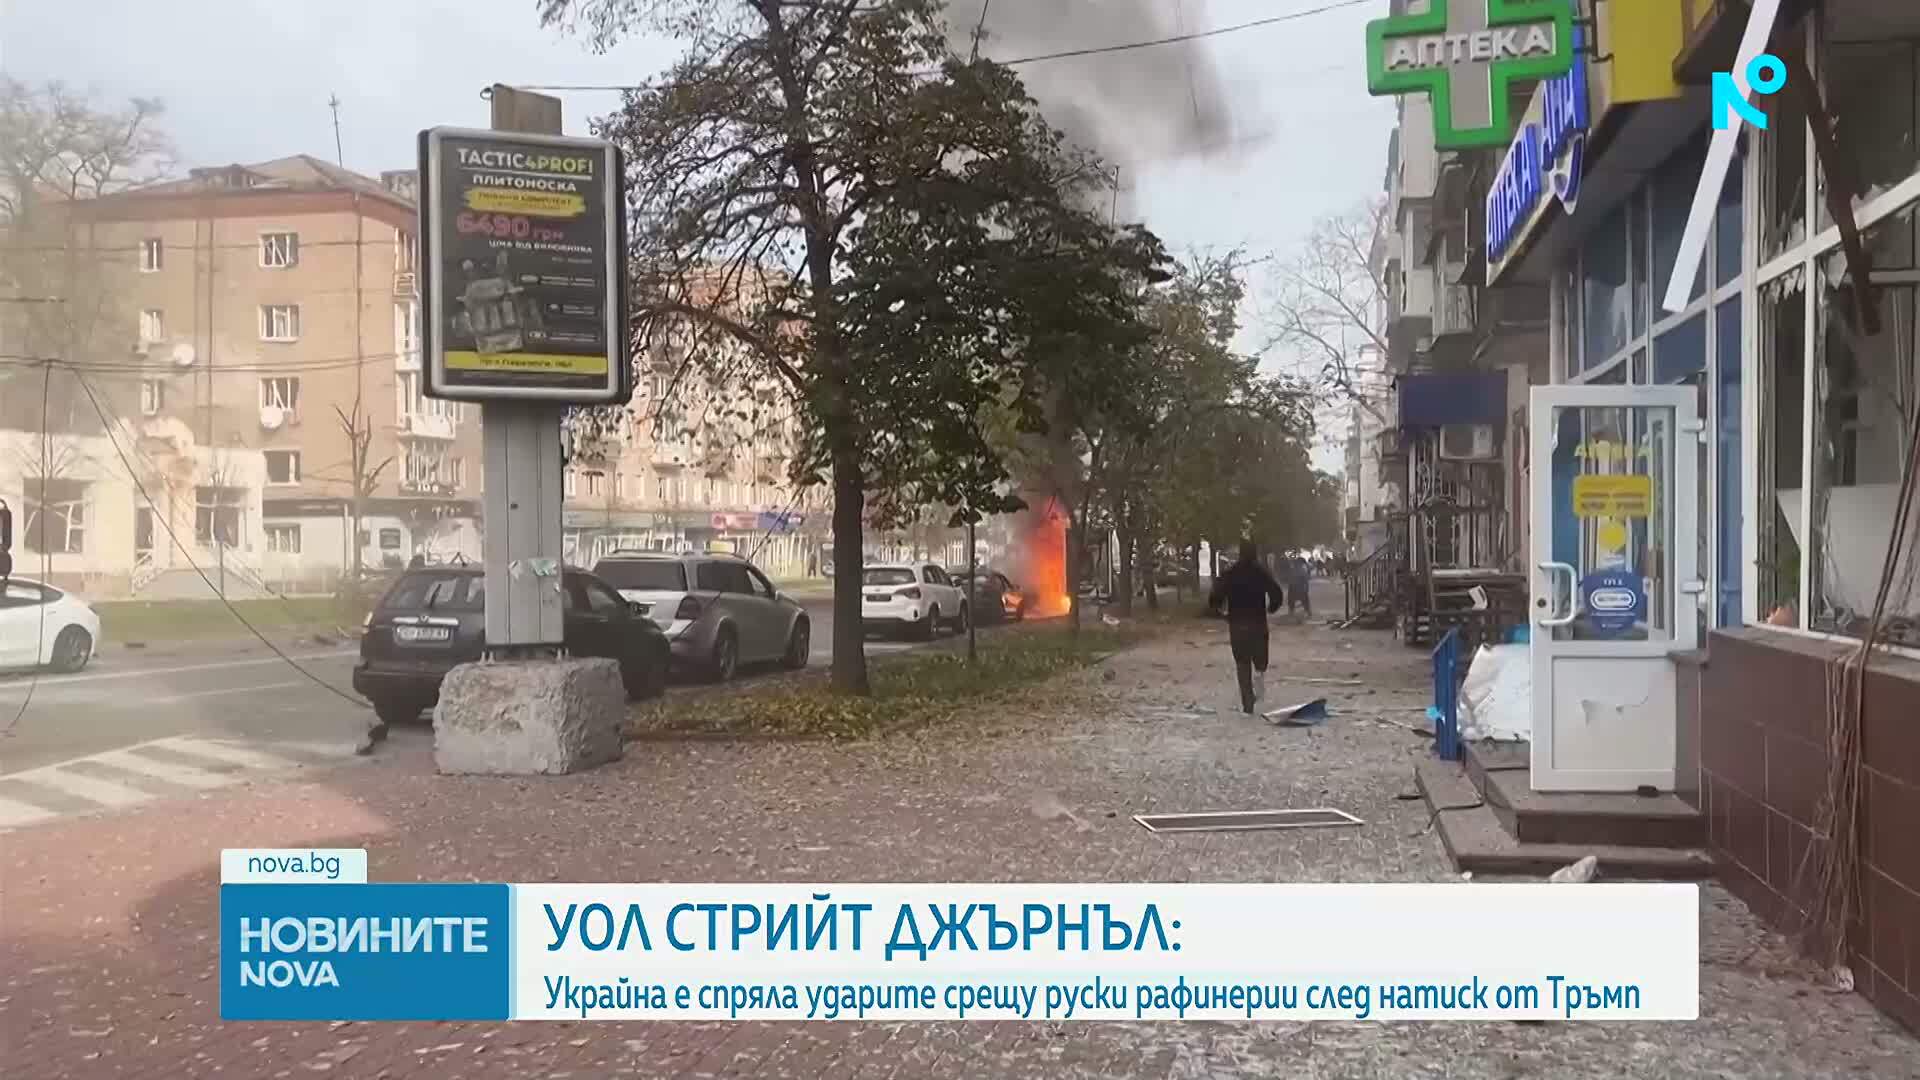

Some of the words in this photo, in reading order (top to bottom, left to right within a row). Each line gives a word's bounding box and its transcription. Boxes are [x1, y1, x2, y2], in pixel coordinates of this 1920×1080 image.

[1390, 26, 1551, 69] АПТЕКА
[457, 148, 593, 174] TACTIC4PROFI
[472, 173, 577, 192] ПЛИТОНОСКА
[1487, 124, 1535, 258] АПТЕКА
[456, 212, 530, 237] 6490
